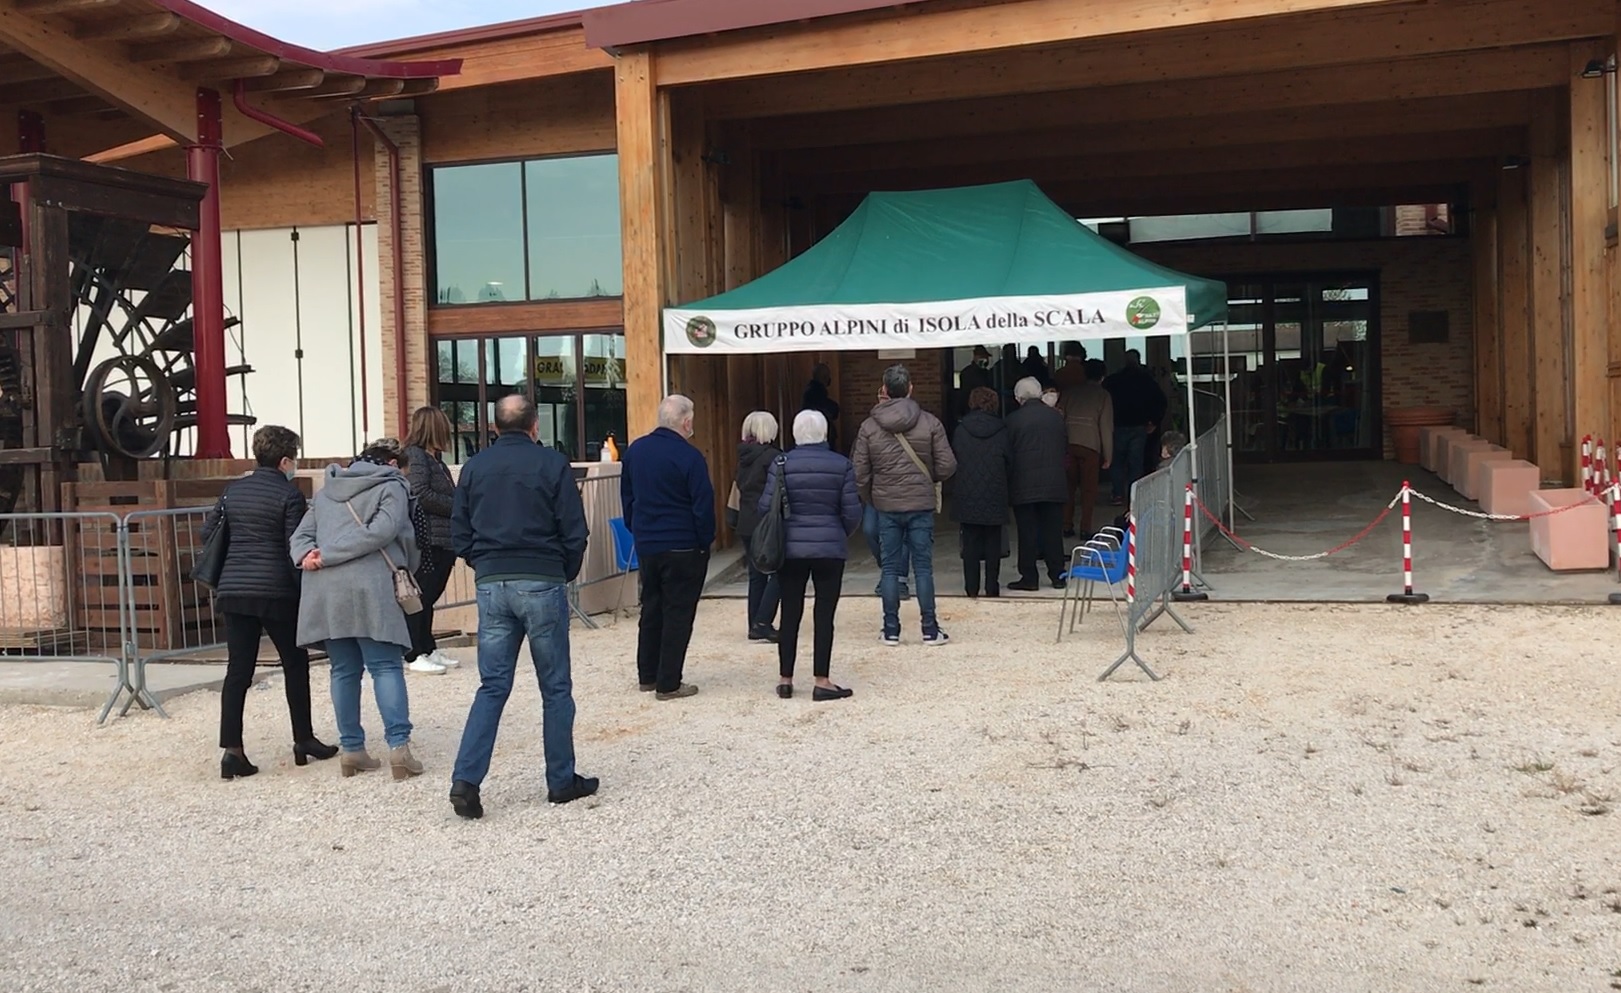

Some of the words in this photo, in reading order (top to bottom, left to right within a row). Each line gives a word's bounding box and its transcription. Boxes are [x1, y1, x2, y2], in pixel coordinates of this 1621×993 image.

[733, 321, 815, 339] GRUPPO
[820, 319, 887, 337] ALPINI
[893, 319, 909, 334] di
[919, 314, 981, 333] ISOLA
[986, 312, 1029, 329] della
[1033, 308, 1106, 327] SCALA
